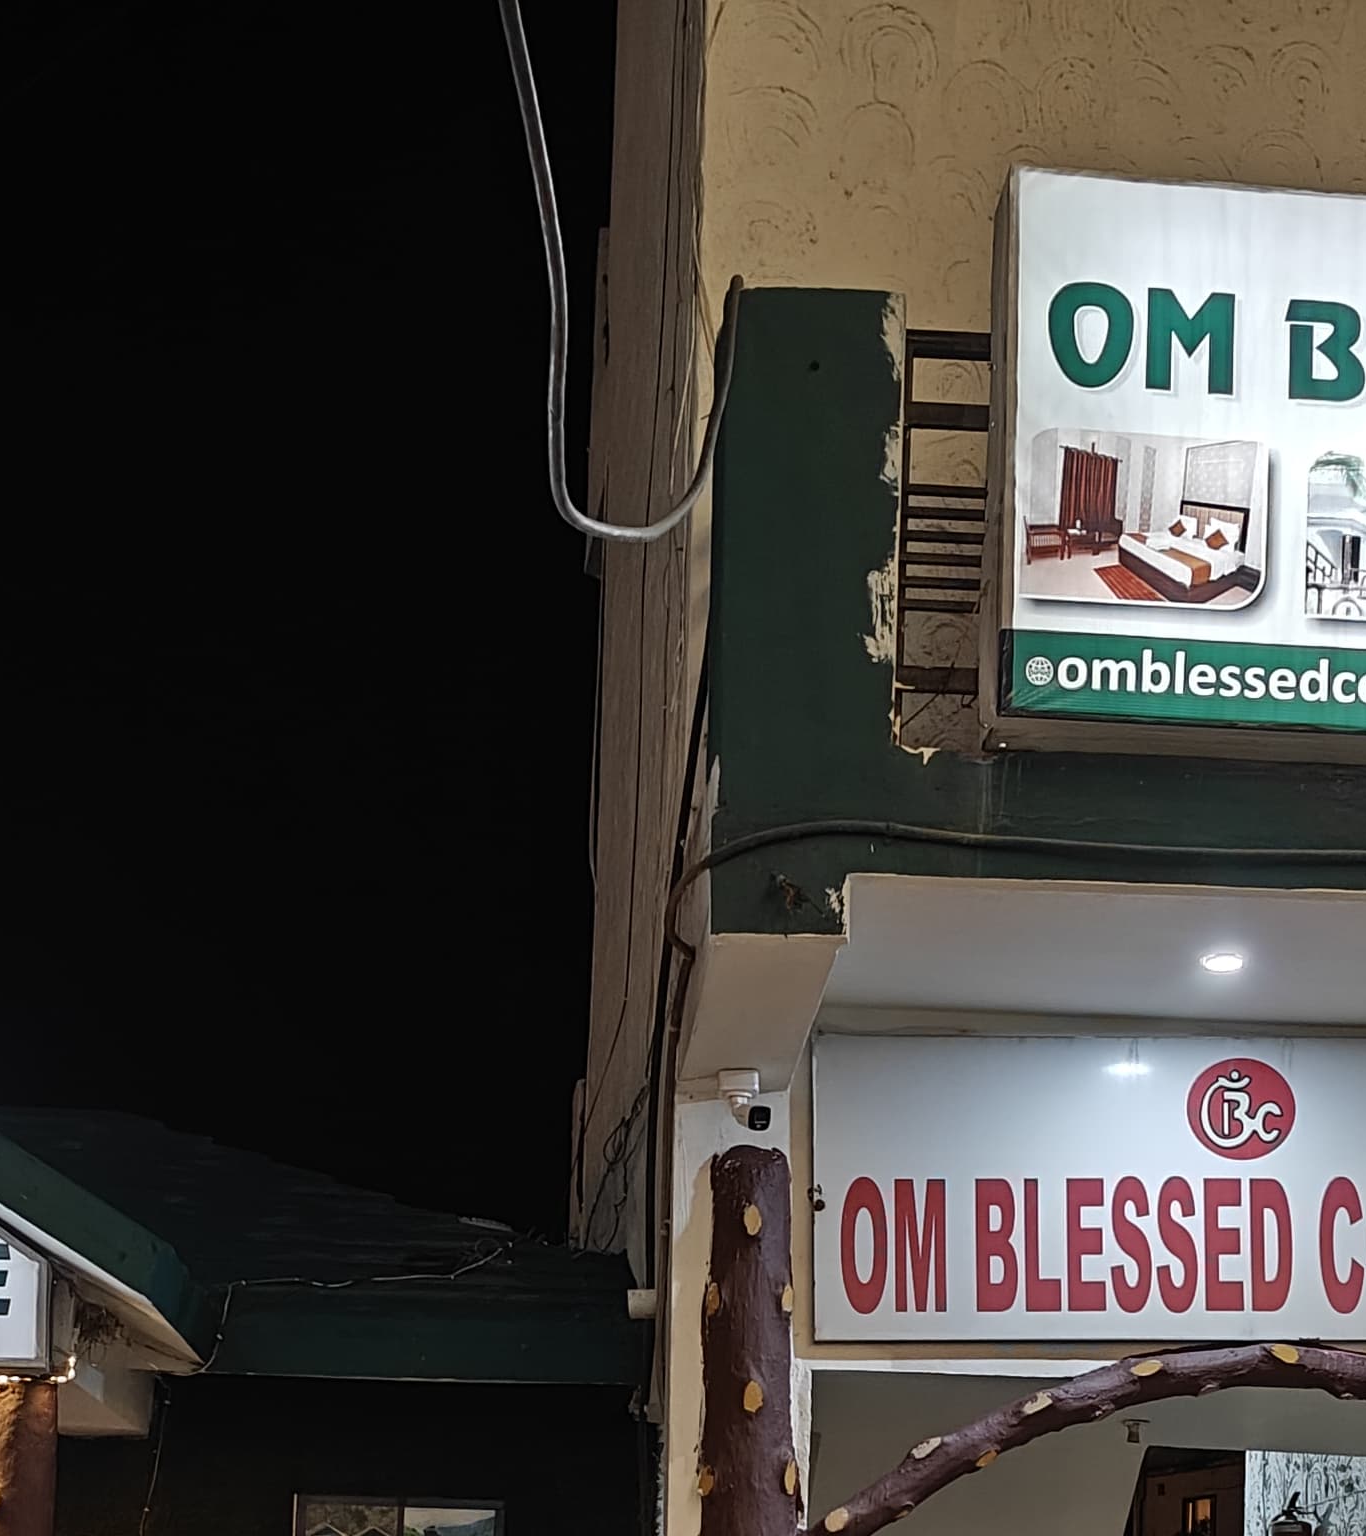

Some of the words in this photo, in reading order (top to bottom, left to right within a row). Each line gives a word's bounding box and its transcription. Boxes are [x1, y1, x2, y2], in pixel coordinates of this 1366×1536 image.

[1047, 281, 1236, 395] OM
[840, 1176, 947, 1316] OM
[975, 1176, 1294, 1316] BLESSED
